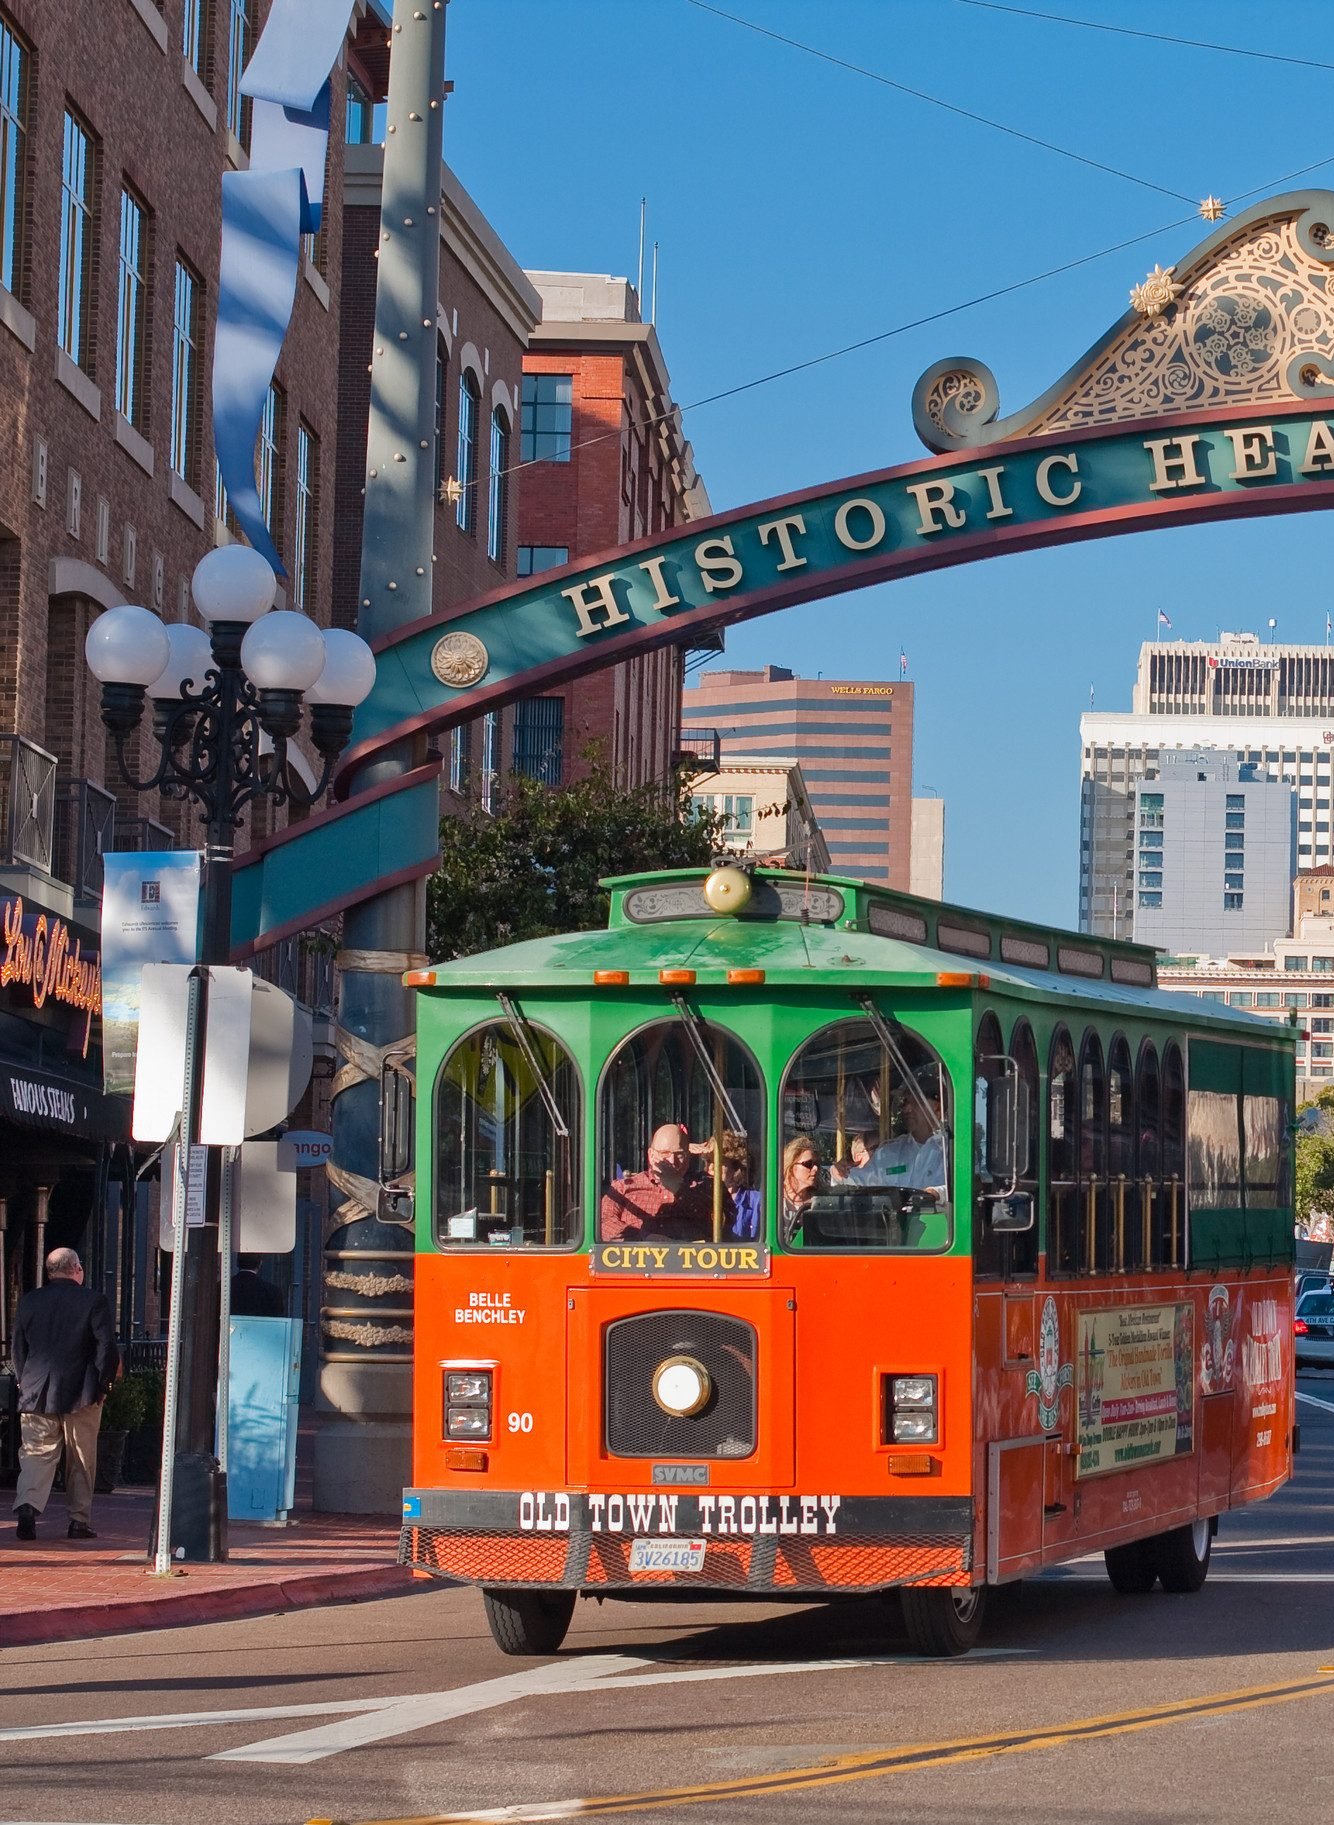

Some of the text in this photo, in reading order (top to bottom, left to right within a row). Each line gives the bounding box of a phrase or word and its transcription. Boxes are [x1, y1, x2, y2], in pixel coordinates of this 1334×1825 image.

[561, 452, 1082, 638] HISTORIC
[1220, 658, 1280, 668] UnionBank
[831, 686, 894, 695] WELLS FARGO
[10, 1077, 75, 1124] FAMOUS STEAKS
[602, 1248, 760, 1270] CITY TOUR
[469, 1292, 512, 1308] BELLE
[454, 1308, 526, 1324] BENCHLEY
[507, 1412, 534, 1433] 90
[652, 1466, 708, 1484] SVMC
[519, 1492, 841, 1535] OLD TOWN TROLLEY
[635, 1551, 700, 1567] 3V26185
